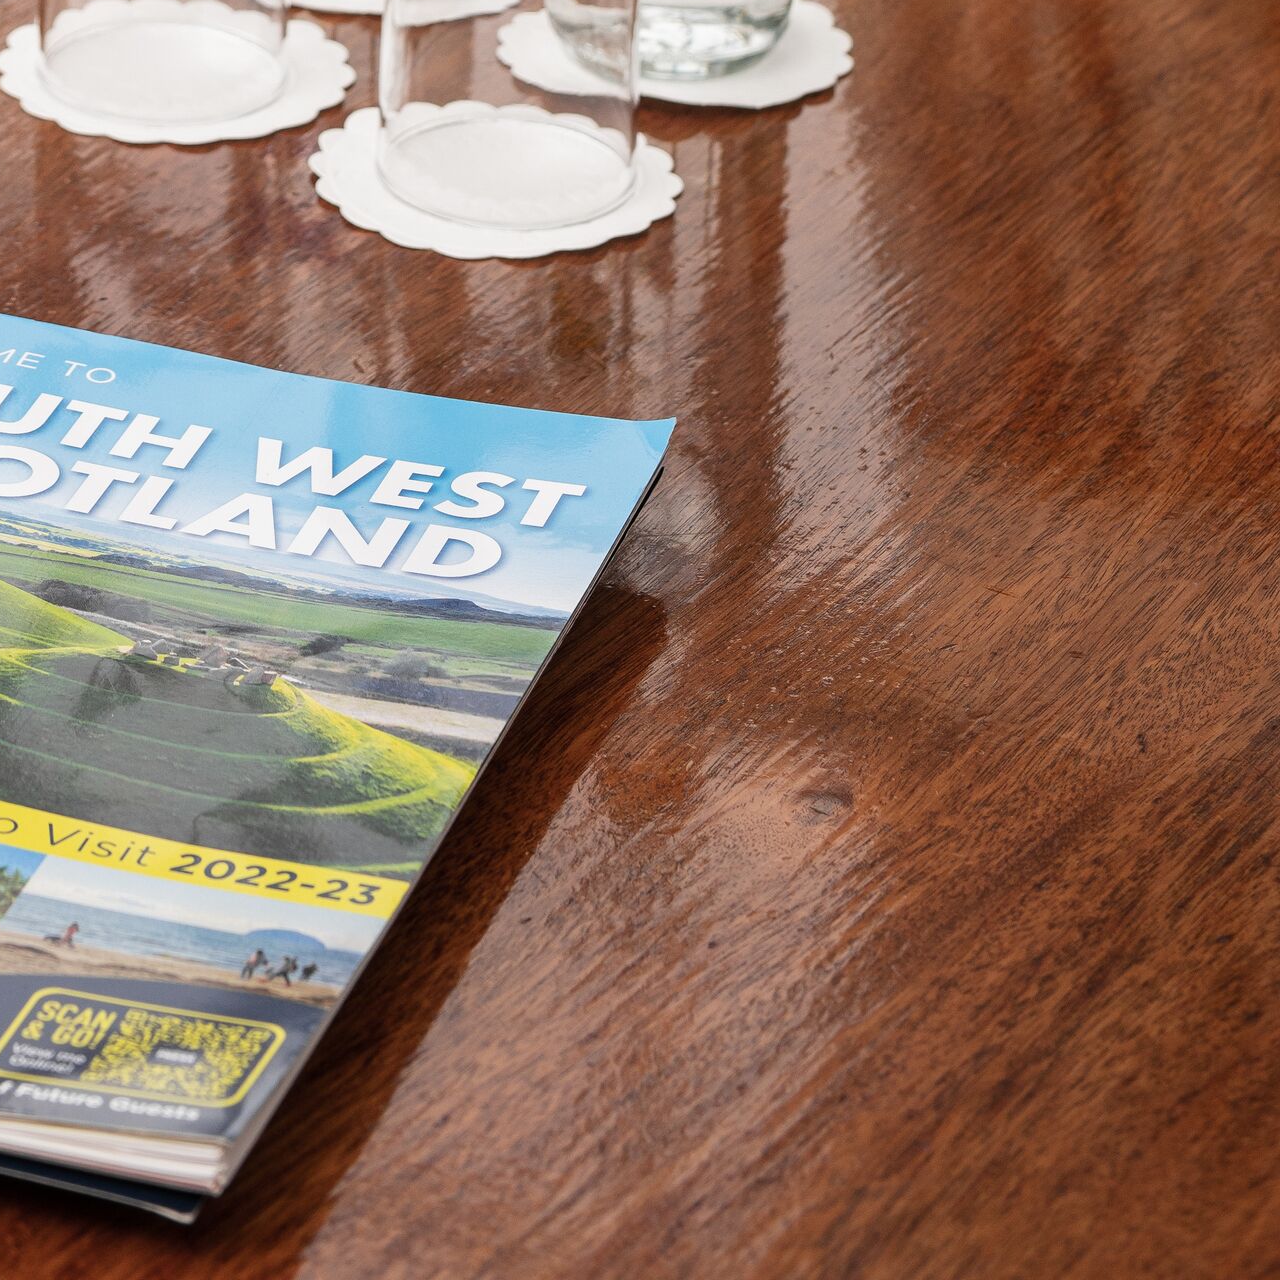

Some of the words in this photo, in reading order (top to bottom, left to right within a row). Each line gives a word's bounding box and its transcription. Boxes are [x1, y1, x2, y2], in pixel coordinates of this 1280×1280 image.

[65, 360, 117, 386] TO
[254, 437, 585, 531] WEST
[46, 822, 153, 866] Visit
[169, 854, 381, 907] 2022-23
[36, 1000, 117, 1030] SCAN
[21, 1019, 44, 1040] &
[51, 1024, 107, 1049] GO!
[14, 1082, 104, 1108] Future
[109, 1096, 200, 1121] Guests
